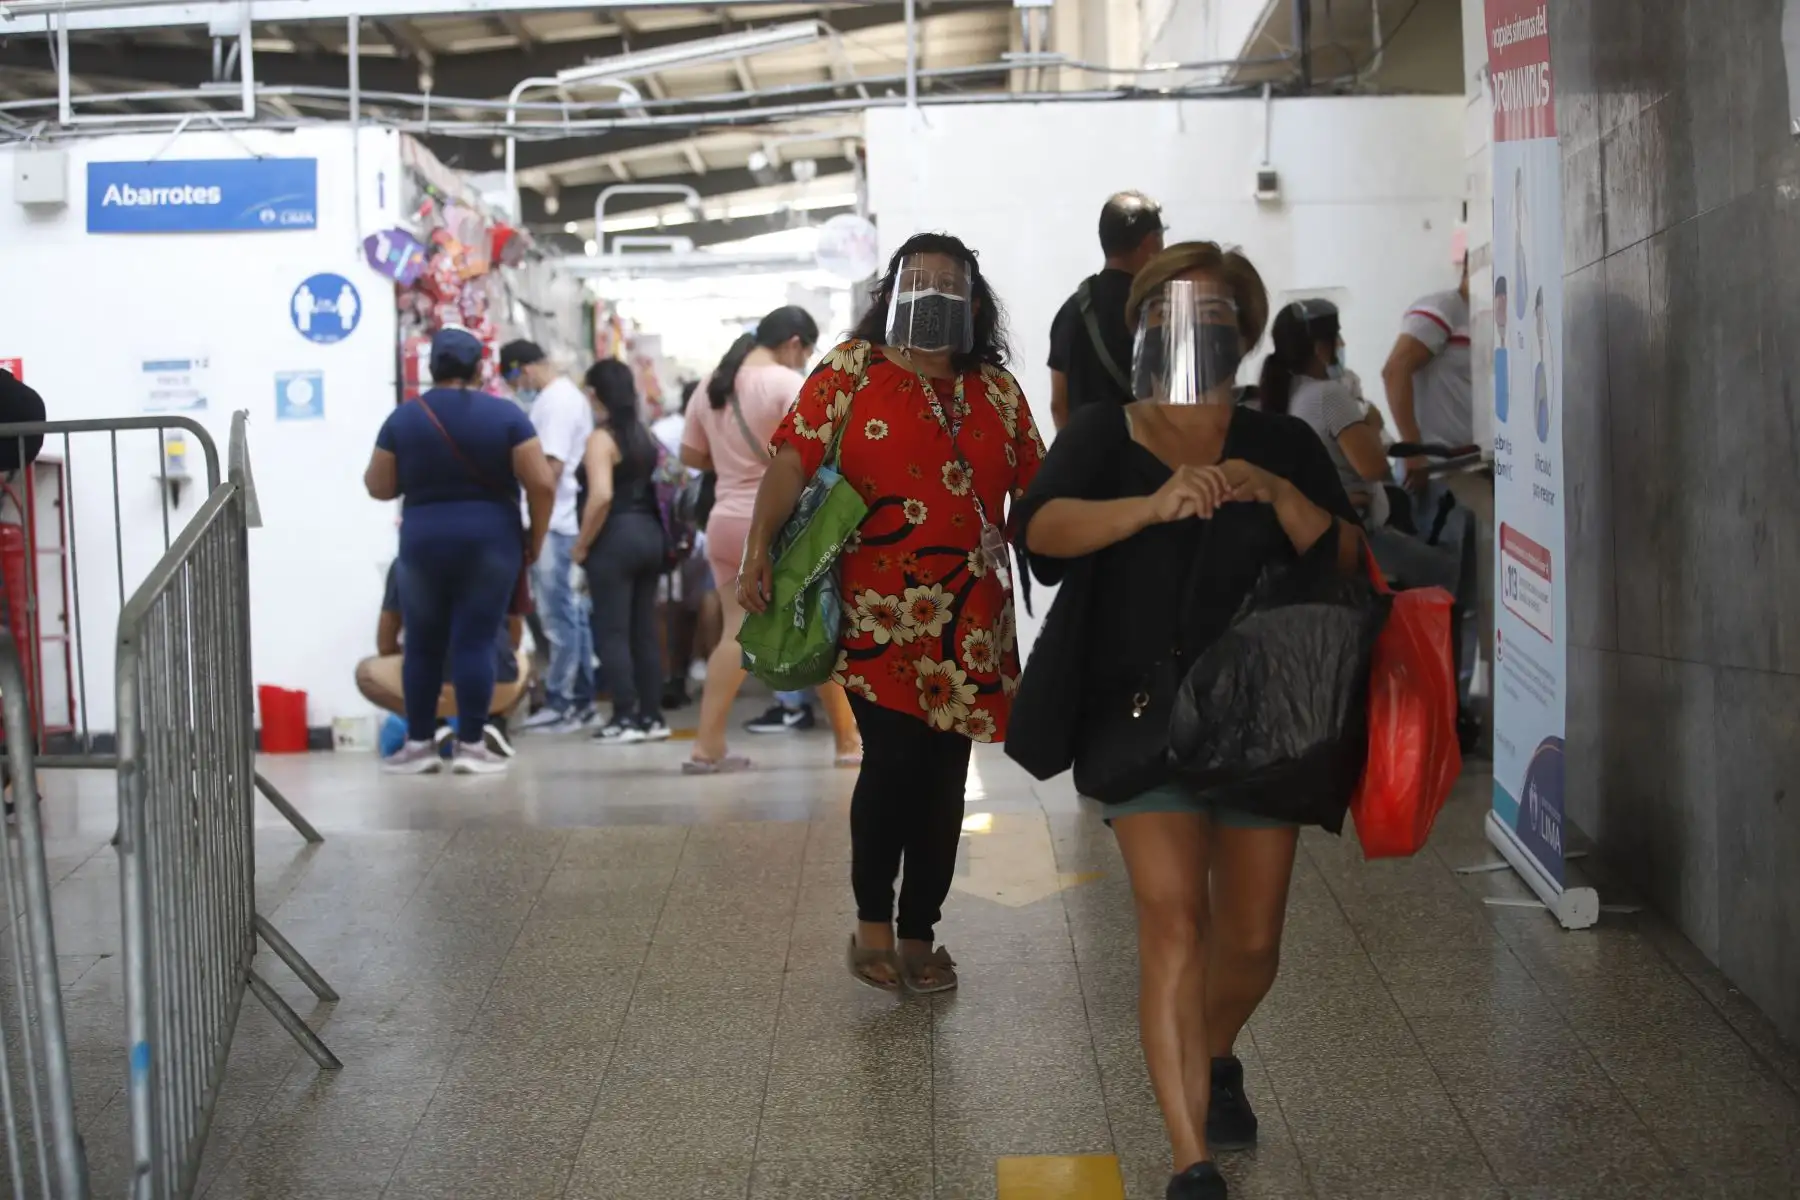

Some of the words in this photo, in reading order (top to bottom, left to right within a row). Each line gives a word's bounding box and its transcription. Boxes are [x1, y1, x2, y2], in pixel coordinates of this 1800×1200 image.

[1536, 5, 1547, 35] del
[102, 183, 222, 207] Abarrotes
[1541, 809, 1562, 858] LIMA
